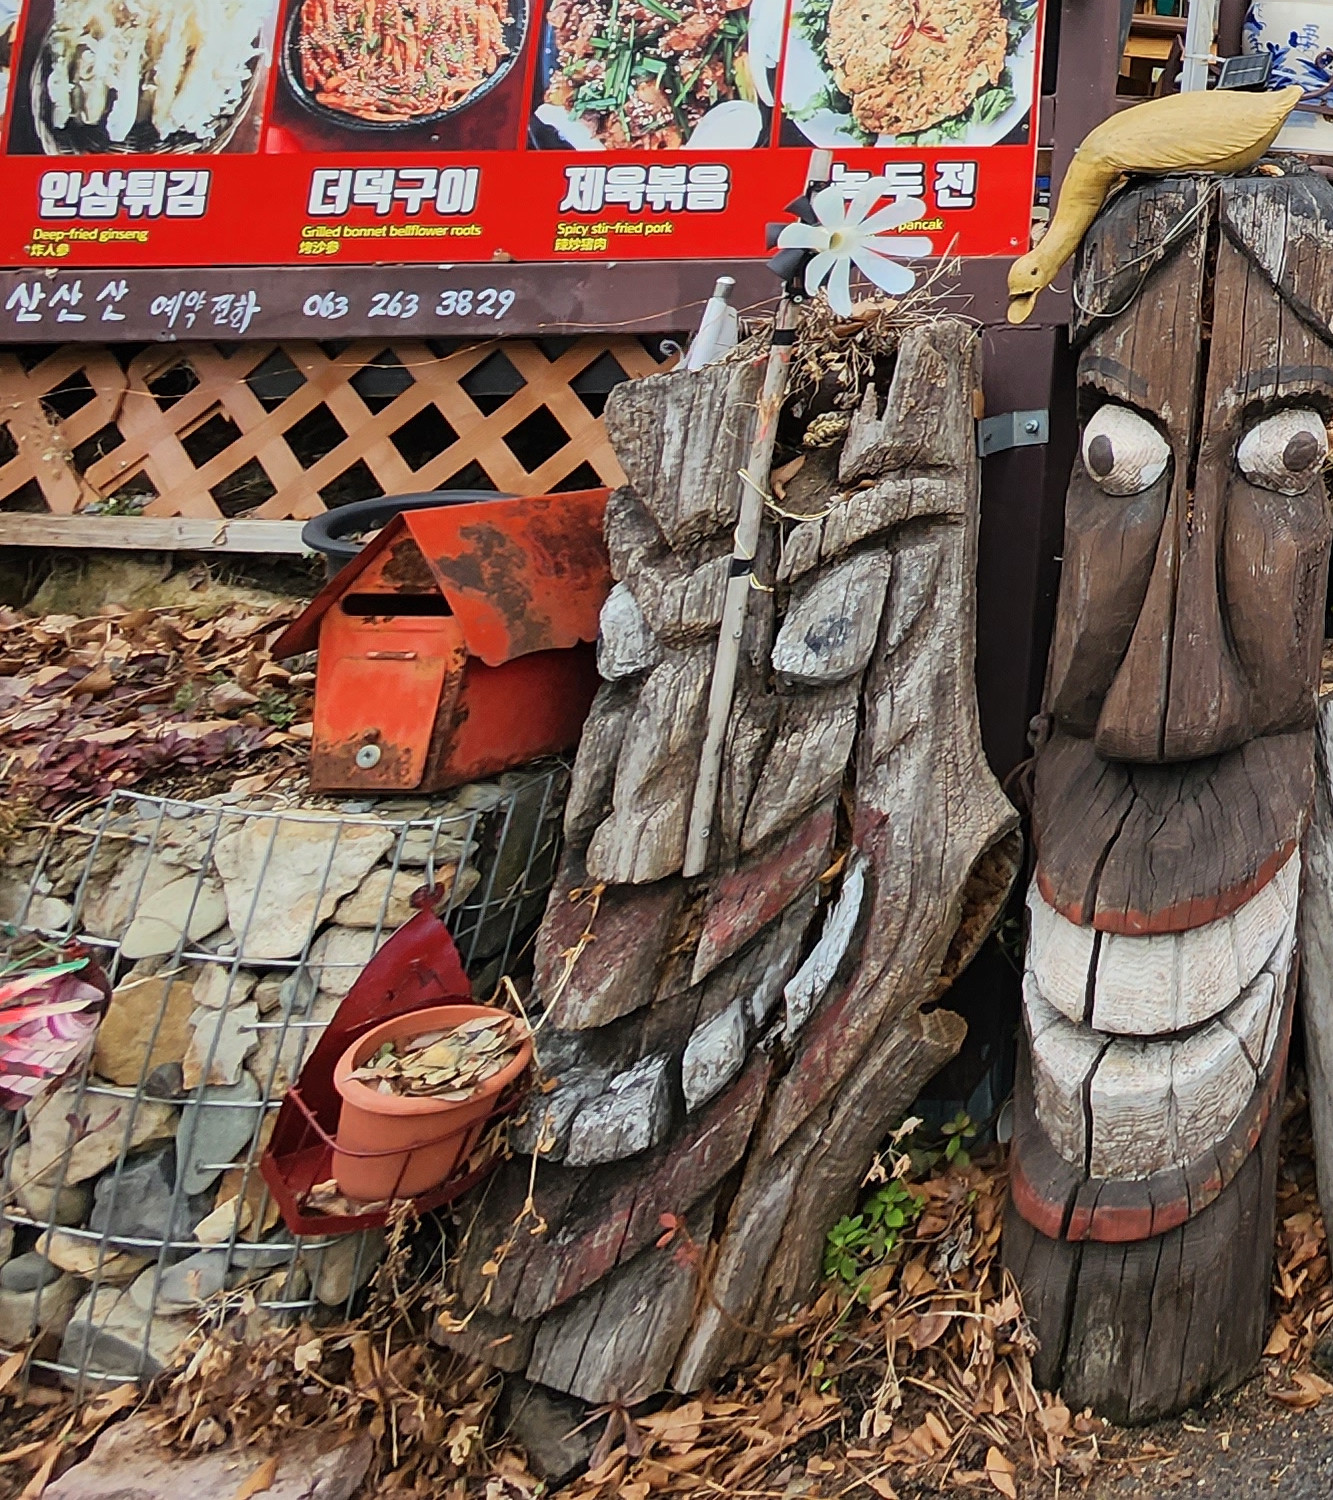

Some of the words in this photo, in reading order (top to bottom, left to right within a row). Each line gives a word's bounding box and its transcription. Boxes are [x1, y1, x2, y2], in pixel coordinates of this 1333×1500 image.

[40, 171, 209, 218] 인삼튀김
[308, 169, 480, 214] 더덕구이
[559, 164, 729, 213] 제육볶음
[33, 228, 98, 241] Deep-fried
[99, 229, 149, 242] ginseng
[302, 226, 341, 238] Grilled
[343, 225, 387, 237] bonnet
[389, 225, 447, 236] bellflower
[449, 224, 482, 235] roots
[557, 223, 589, 236] Spicy
[591, 222, 643, 235] stir-fried
[644, 222, 673, 236] pork
[210, 290, 261, 333] 전화
[303, 290, 349, 320] 063
[368, 291, 419, 319] 263
[435, 288, 515, 320] 3829
